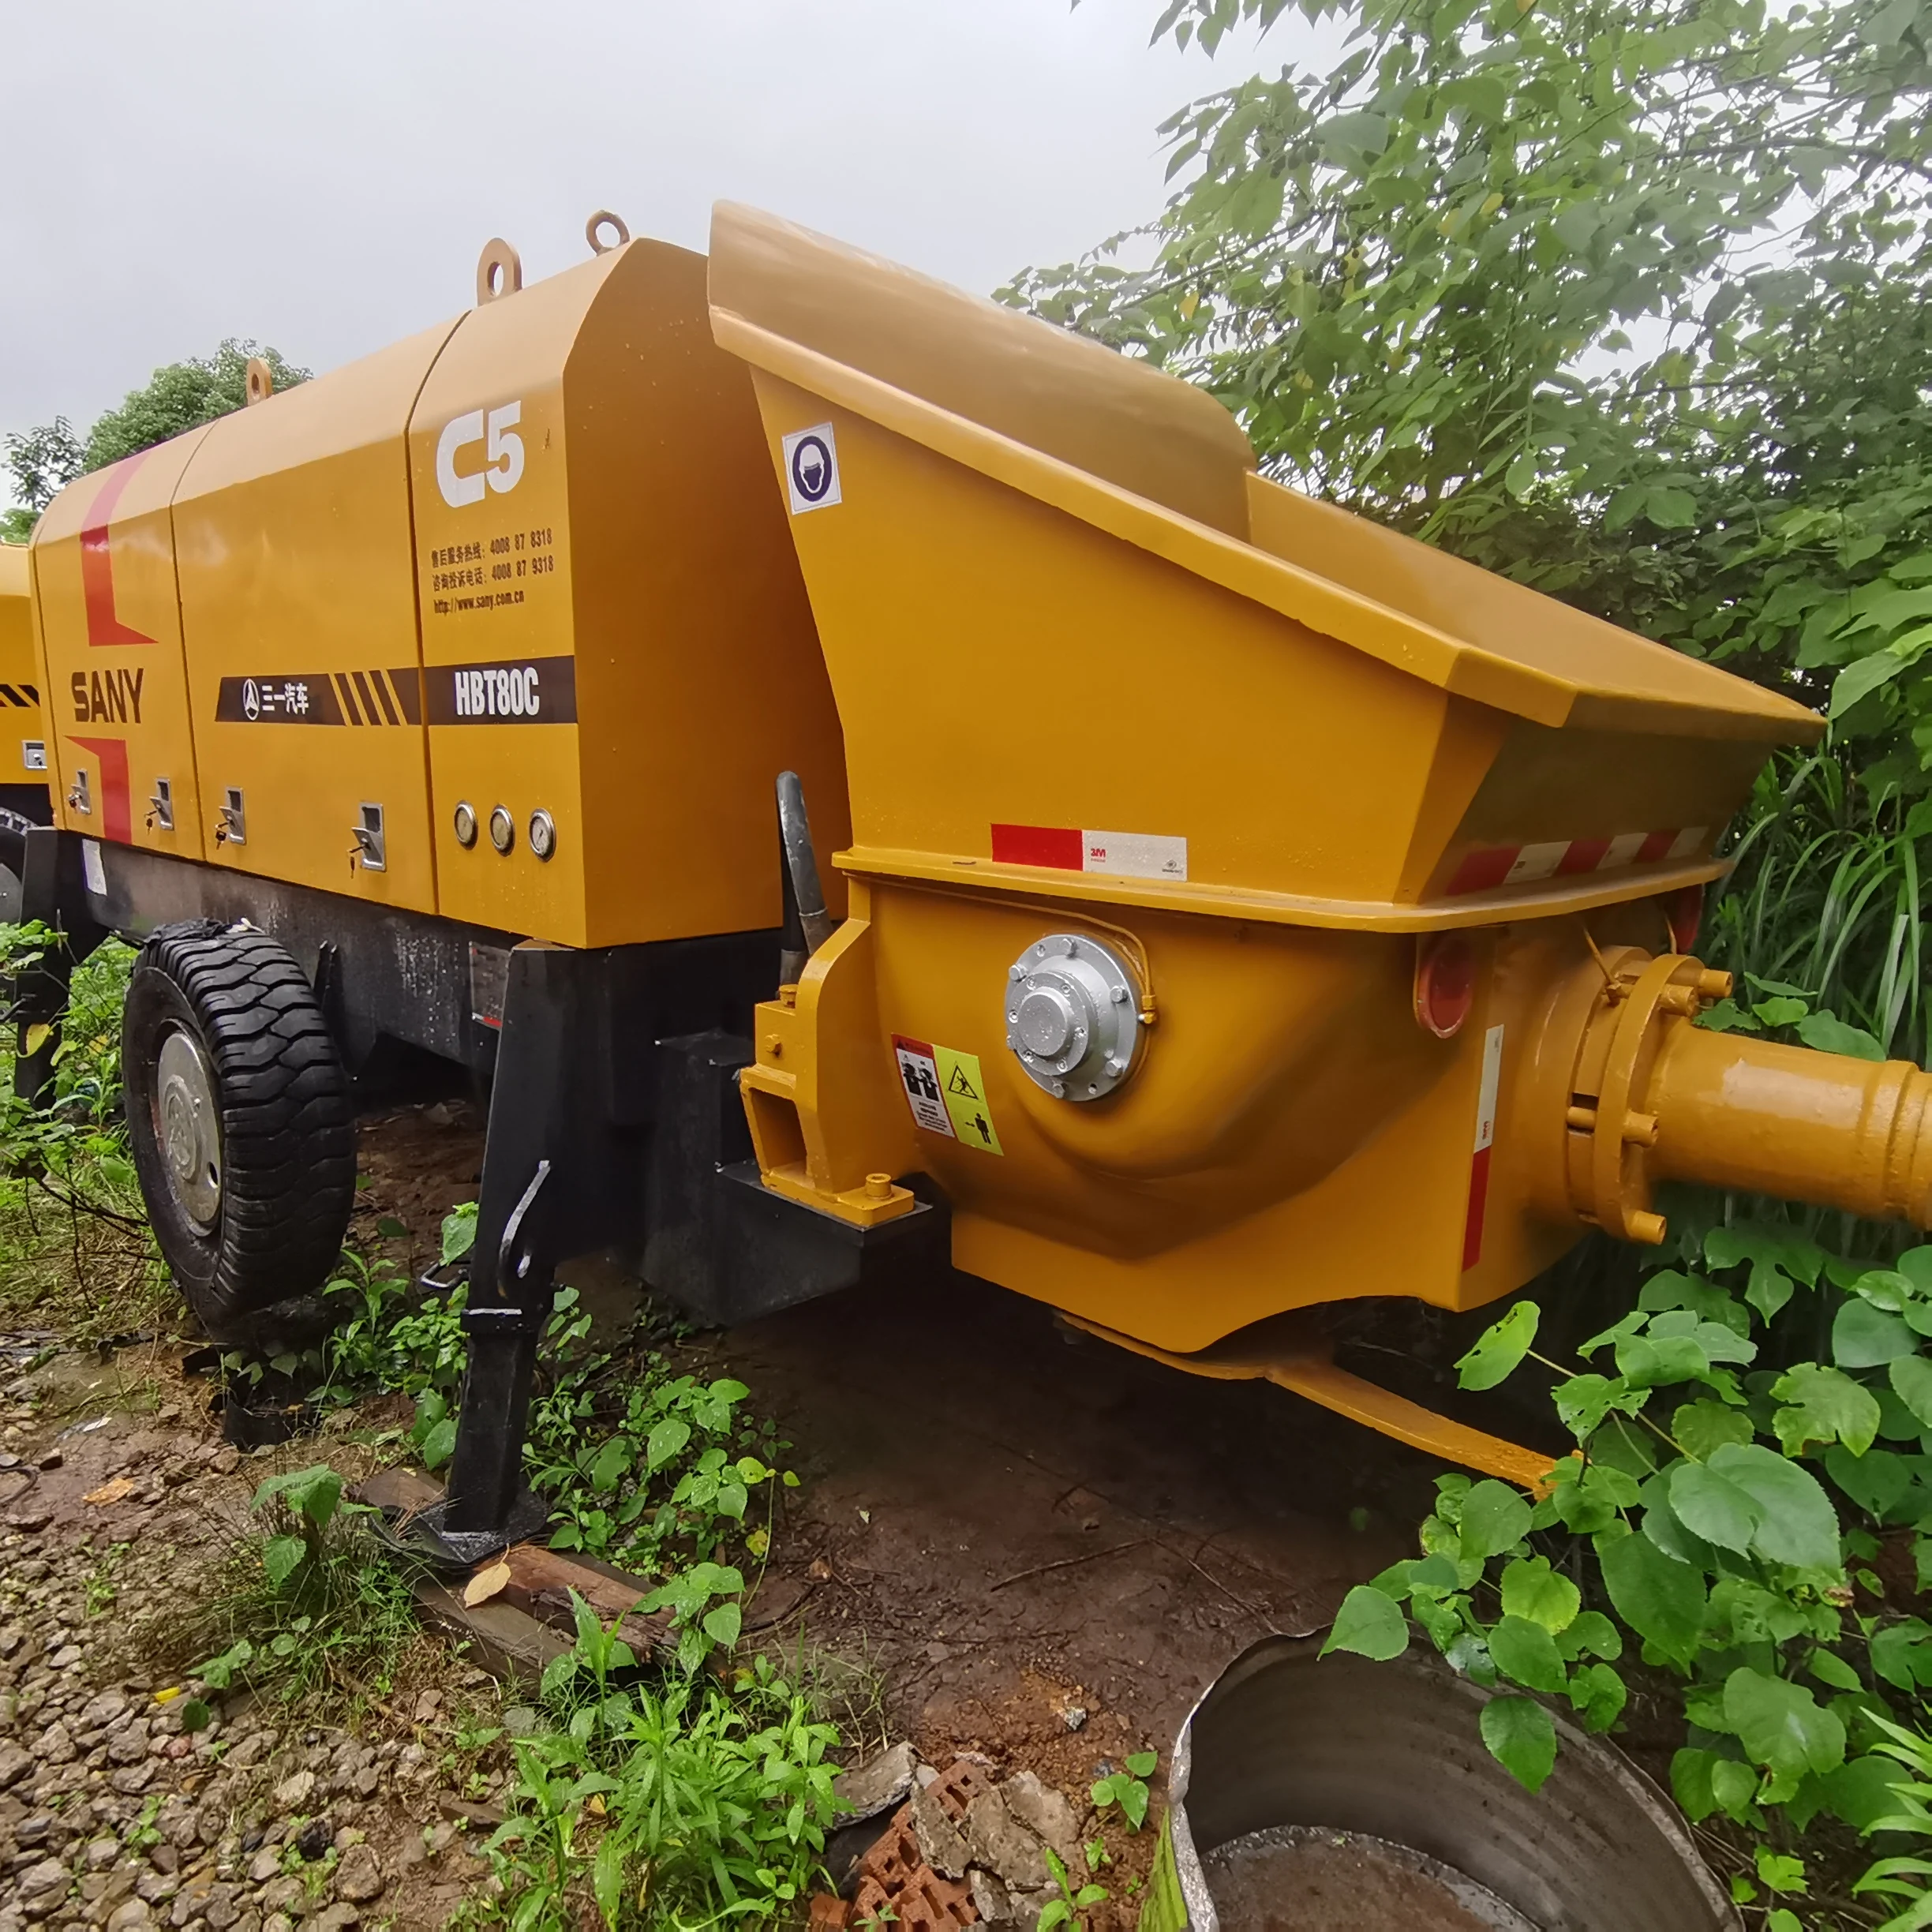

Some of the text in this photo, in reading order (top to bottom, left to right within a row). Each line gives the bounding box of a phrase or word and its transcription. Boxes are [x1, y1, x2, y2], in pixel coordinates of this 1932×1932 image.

[436, 400, 525, 507] C5
[489, 536, 511, 555] 4008
[515, 533, 525, 550] 87
[530, 527, 552, 548] 8318
[492, 562, 512, 581] 4008
[516, 560, 526, 577] 87
[532, 555, 554, 575] 9318
[433, 590, 525, 616] http://www.sany.com.cn
[71, 668, 144, 724] SANY
[261, 683, 309, 714] 三一汽车
[455, 667, 540, 716] HBT80C
[1091, 848, 1106, 857] 3M
